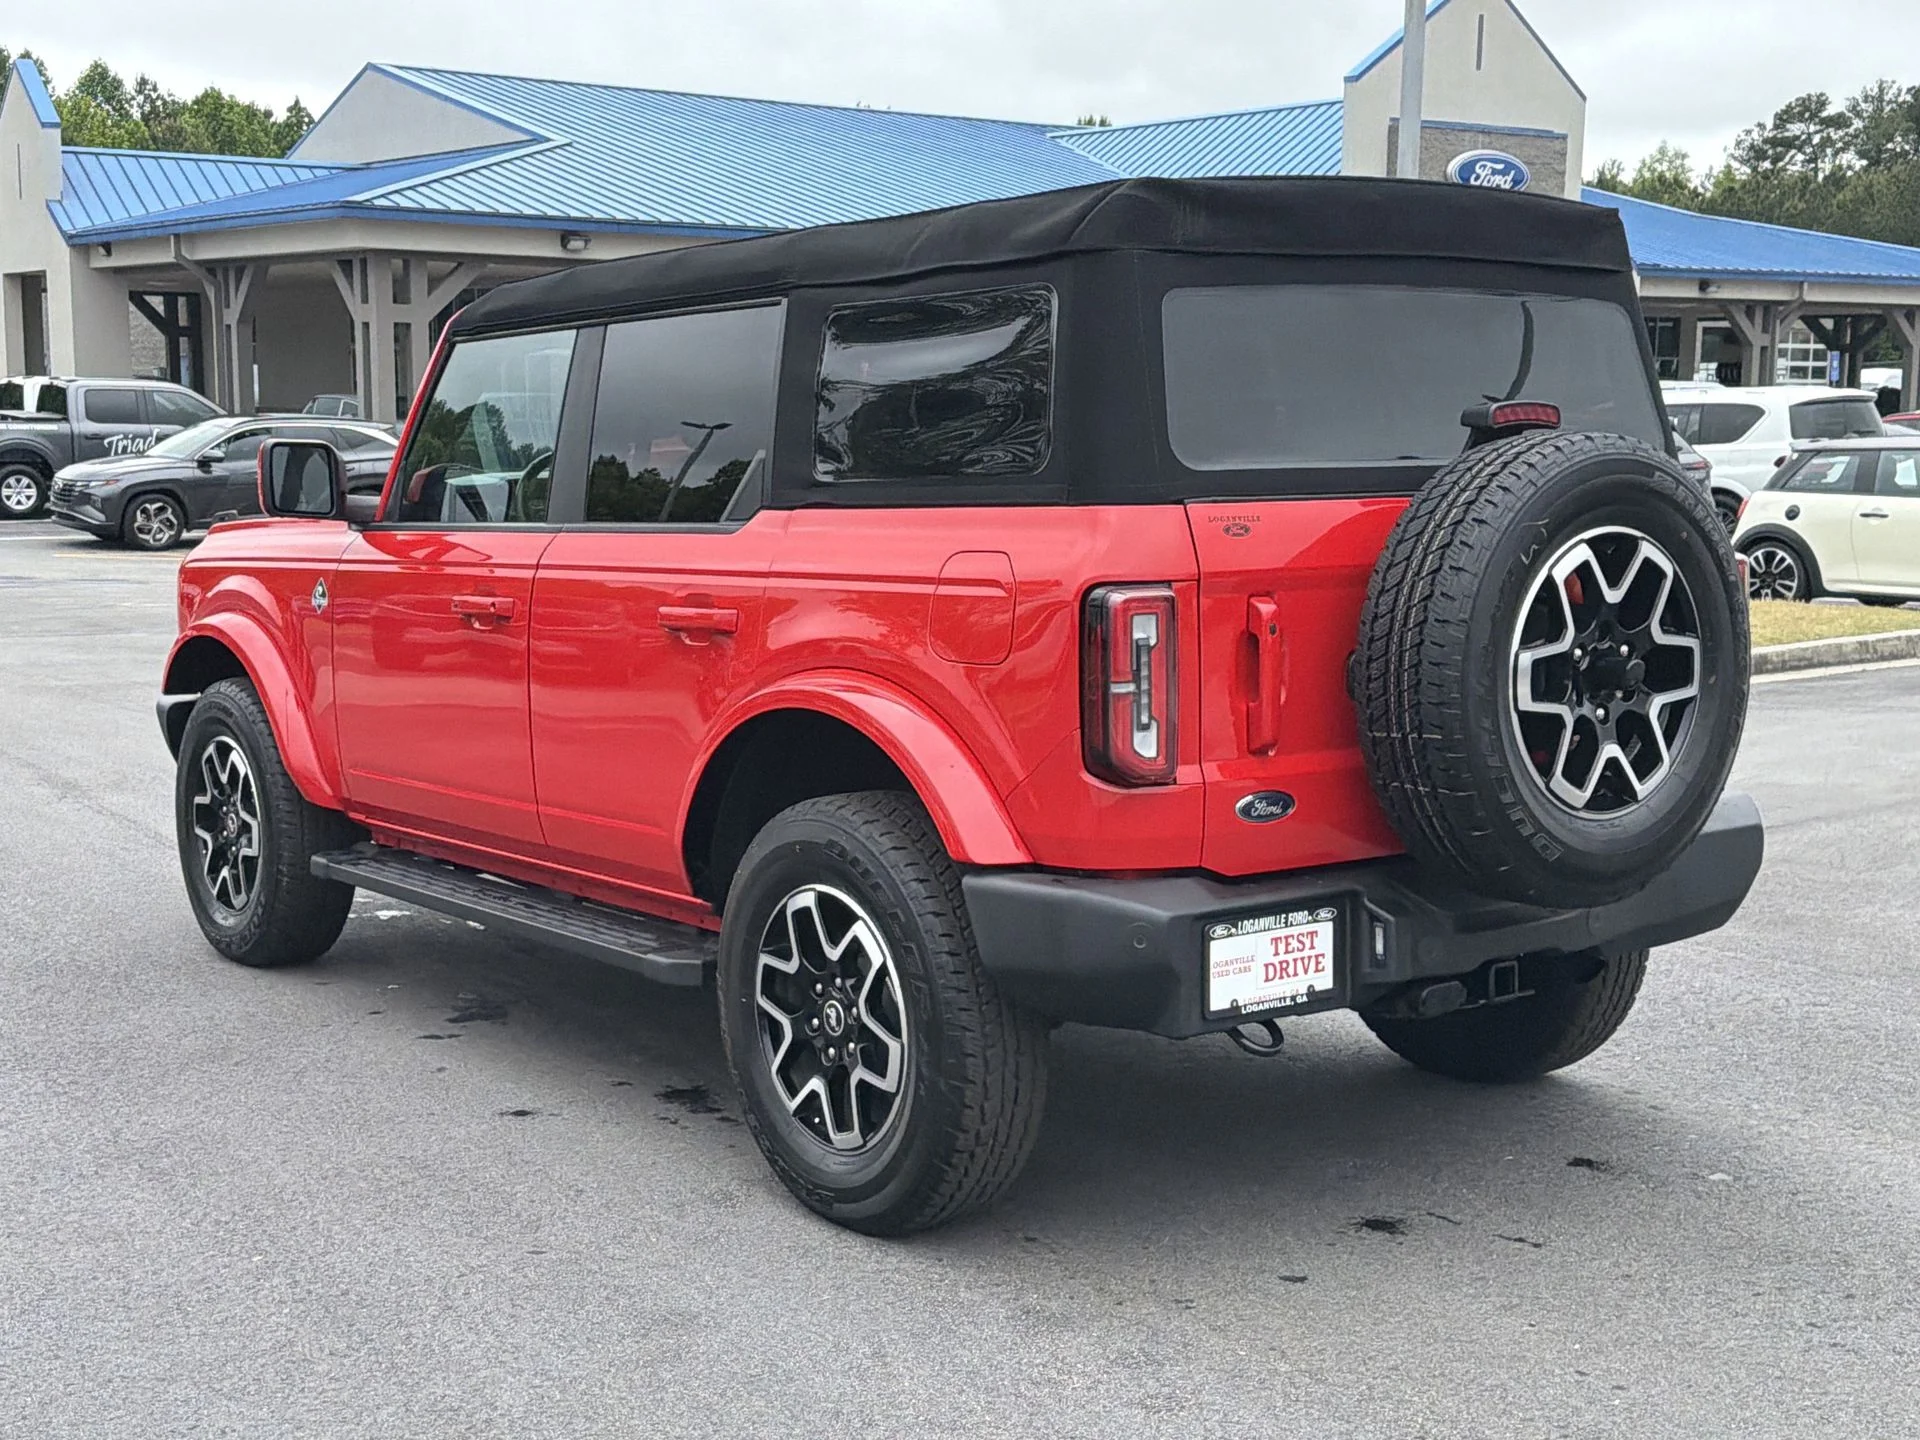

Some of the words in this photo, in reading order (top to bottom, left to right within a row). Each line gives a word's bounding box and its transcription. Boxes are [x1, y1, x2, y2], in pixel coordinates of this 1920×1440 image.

[1470, 161, 1515, 190] Ford
[104, 428, 160, 457] Triad
[1207, 515, 1262, 523] LOGANVILLE
[1251, 799, 1284, 817] Ford
[1237, 913, 1286, 935] LOGANVILLE
[1287, 910, 1309, 927] FORD
[1270, 930, 1318, 956] TEST
[1212, 955, 1256, 969] OGANVILLE
[1232, 965, 1252, 975] CARS
[1263, 953, 1325, 983] DRIVE
[1241, 997, 1295, 1014] LOGANVILLE,
[1295, 994, 1308, 1003] GA
